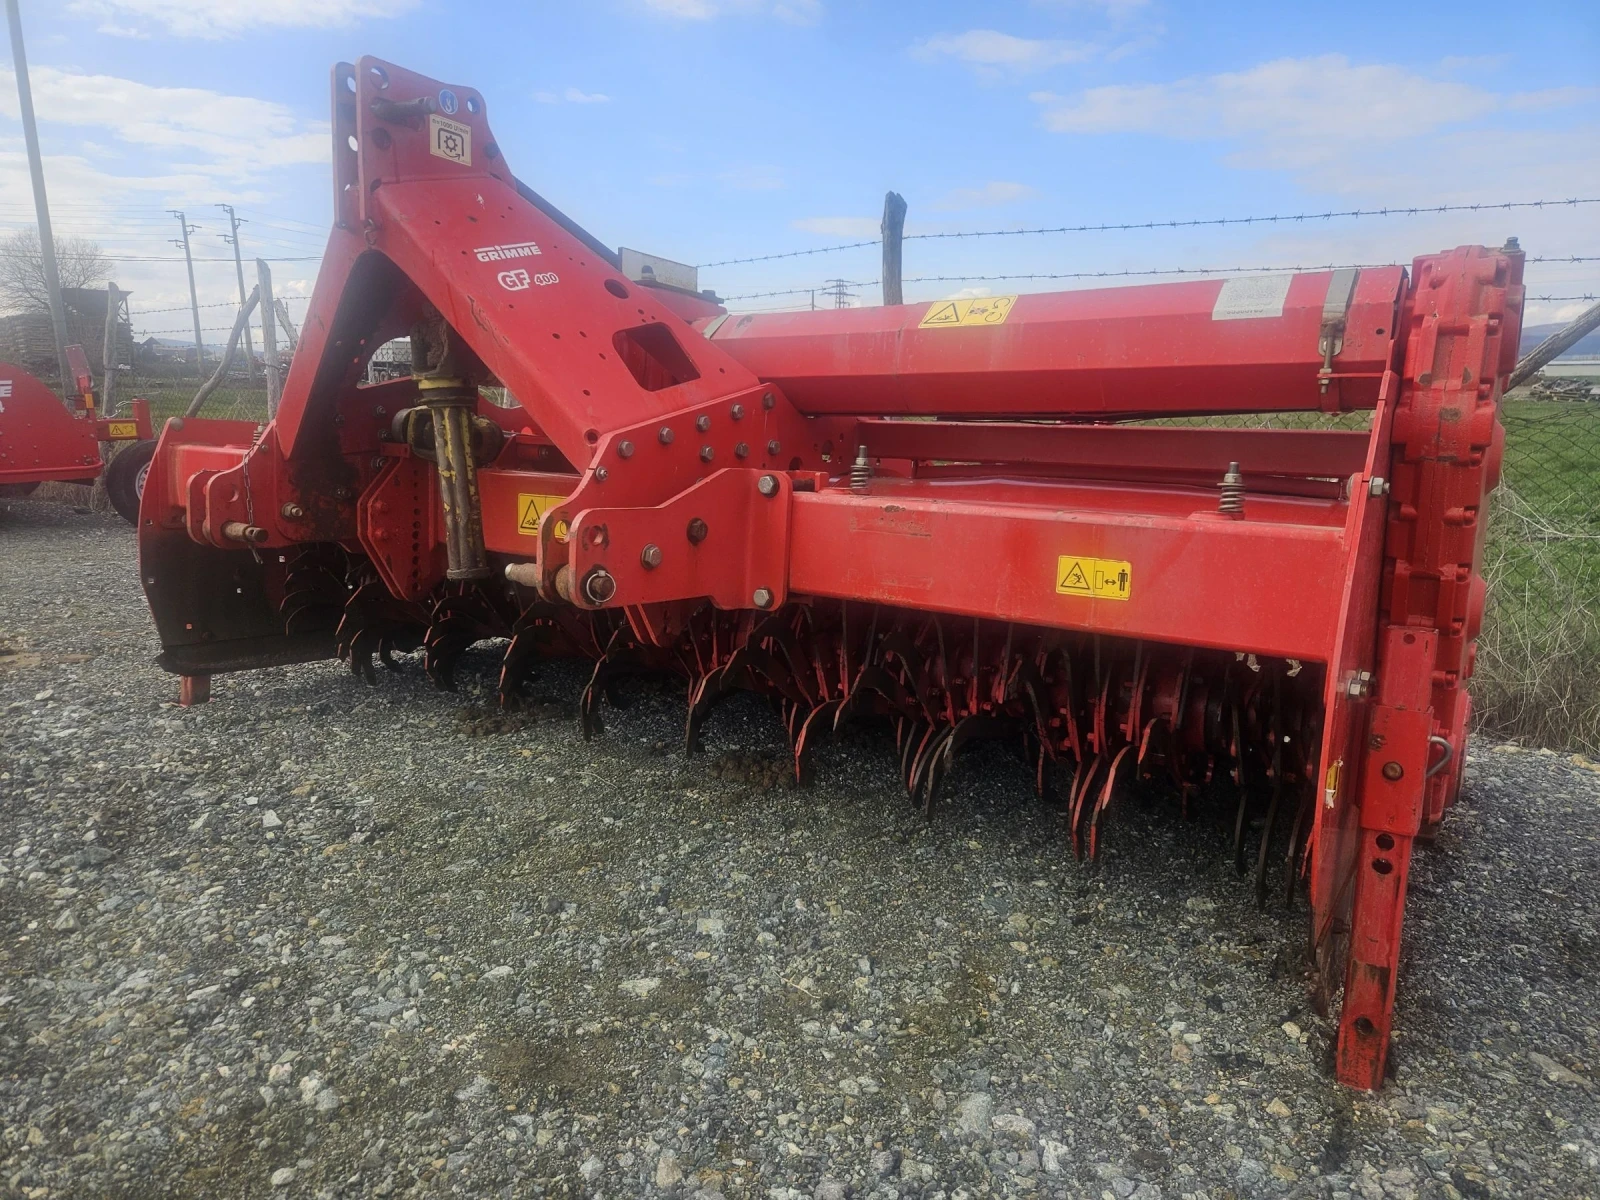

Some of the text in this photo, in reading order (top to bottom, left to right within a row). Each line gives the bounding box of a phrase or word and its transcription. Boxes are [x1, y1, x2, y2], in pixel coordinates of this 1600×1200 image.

[474, 242, 542, 262] GRIMME
[497, 269, 559, 291] GF 400
